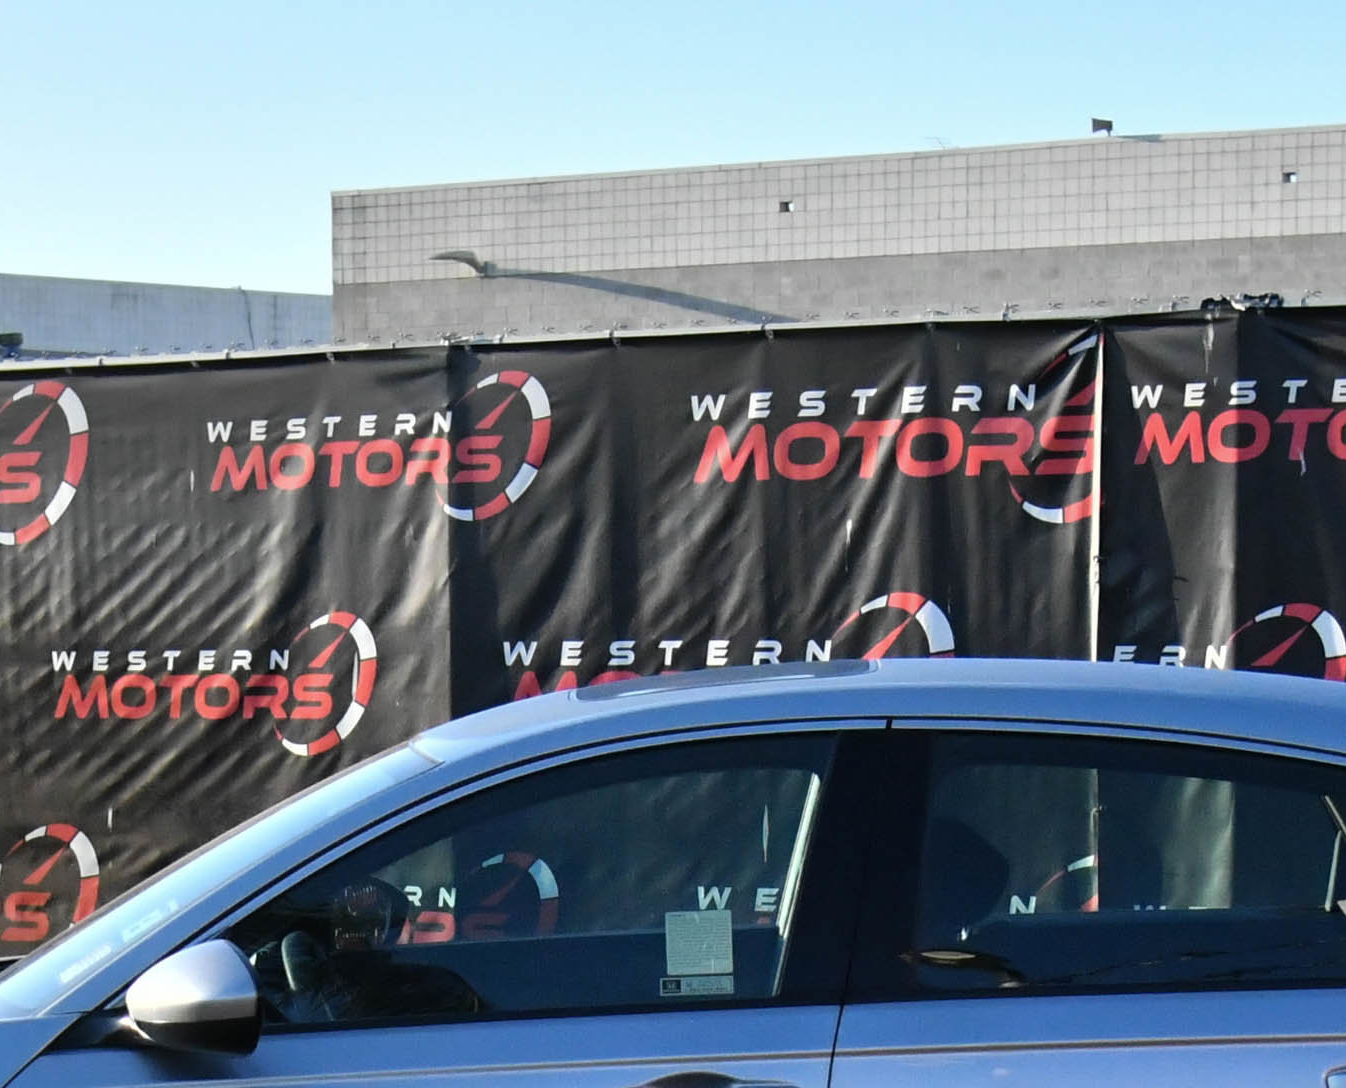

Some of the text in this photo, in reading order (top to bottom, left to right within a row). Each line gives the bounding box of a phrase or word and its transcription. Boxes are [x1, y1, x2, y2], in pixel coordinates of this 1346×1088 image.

[690, 384, 1036, 422] WESTERN
[207, 411, 452, 443] WESTERN
[210, 434, 503, 492] MOTORS
[693, 416, 1095, 484] MOTORS
[51, 649, 290, 673] WESTERN
[503, 639, 833, 667] WESTERN
[54, 672, 334, 720] MOTORS
